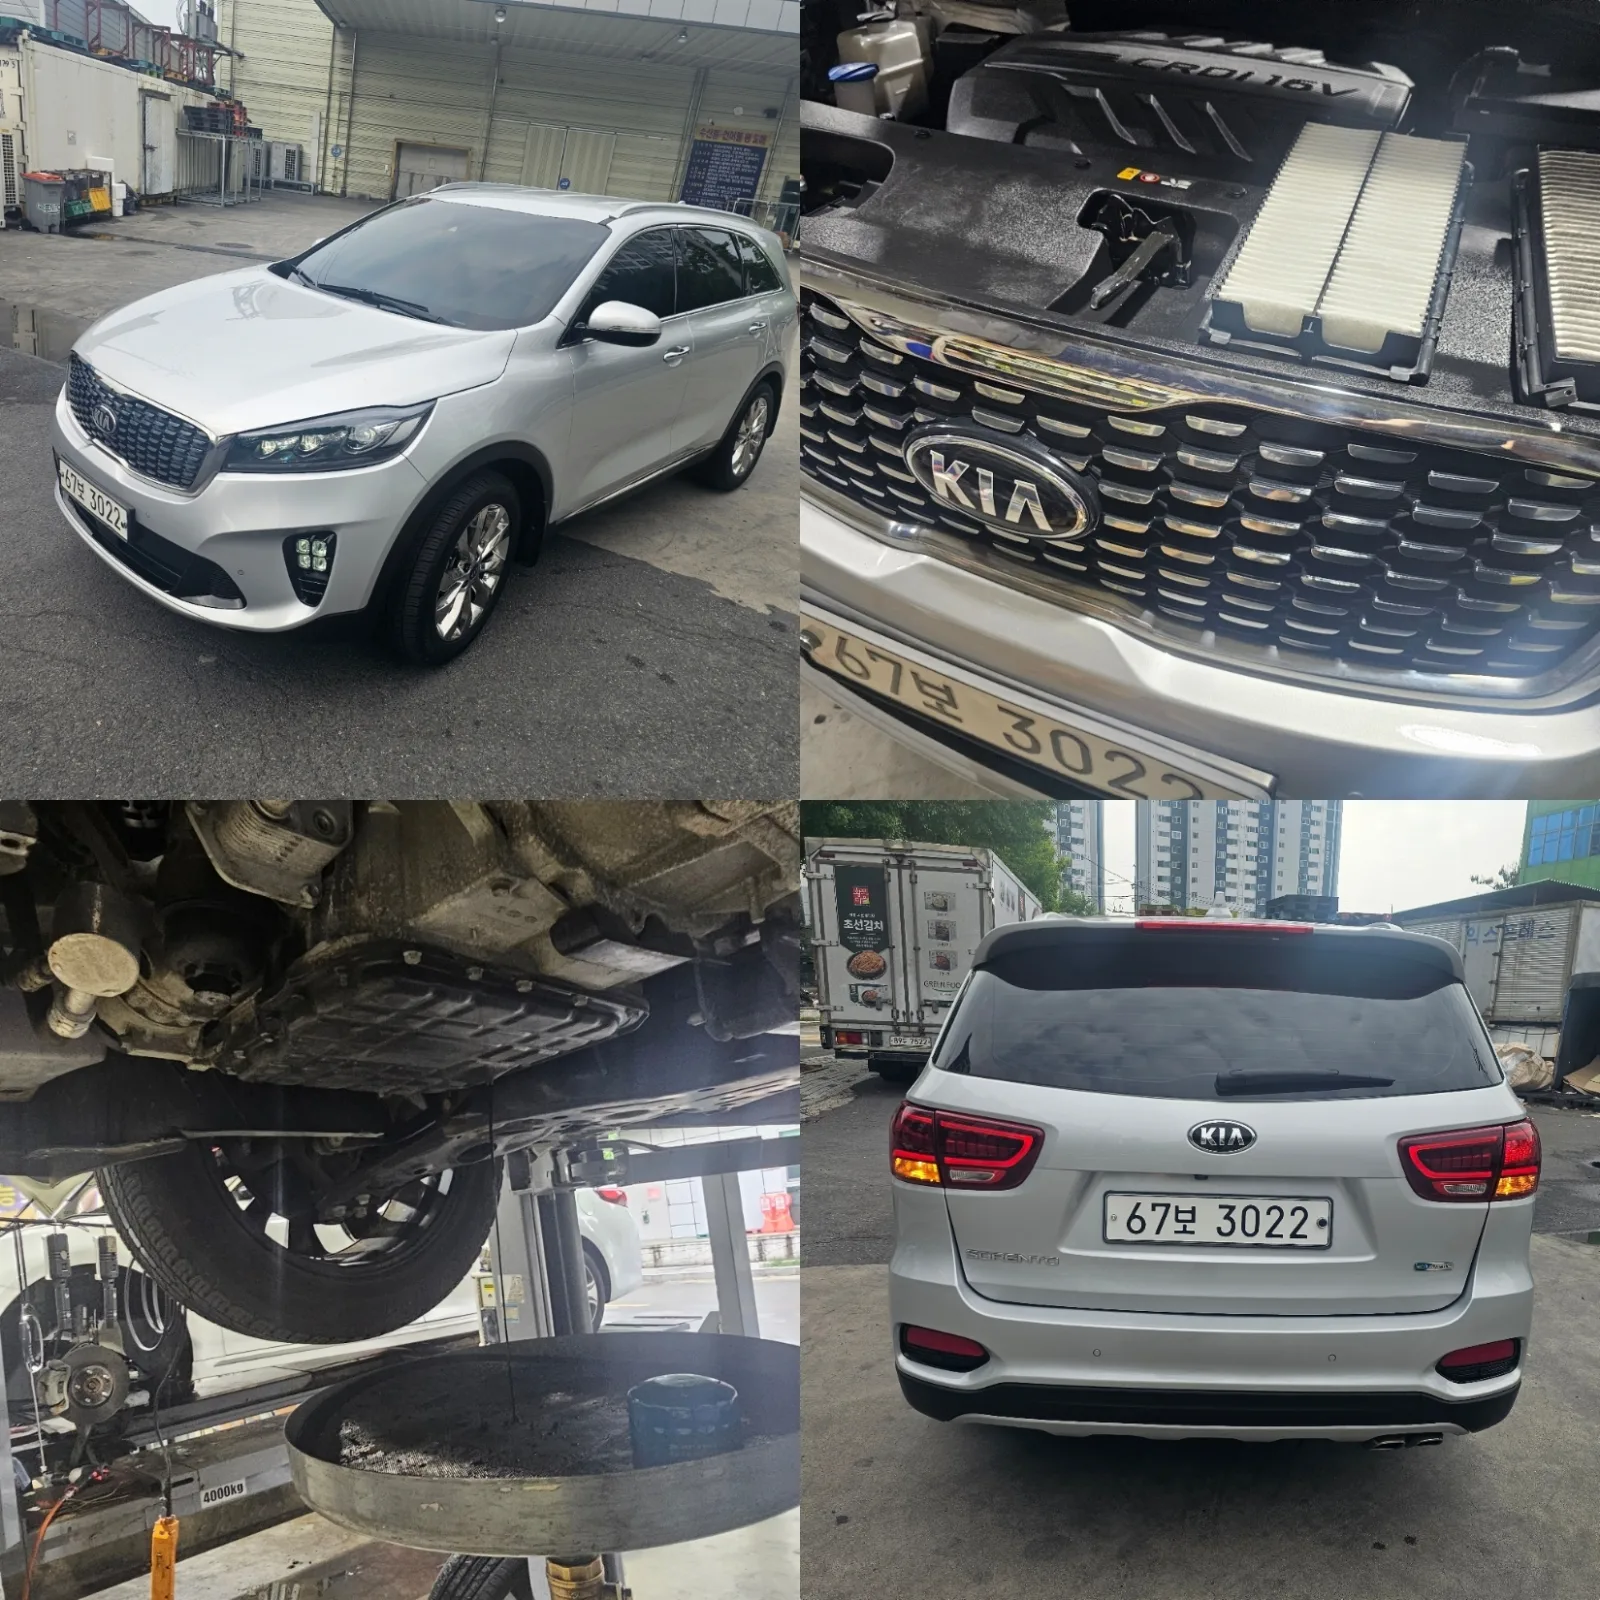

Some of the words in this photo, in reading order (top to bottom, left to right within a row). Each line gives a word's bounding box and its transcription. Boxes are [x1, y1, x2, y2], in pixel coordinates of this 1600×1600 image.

[1269, 73, 1361, 97] 16V
[93, 407, 111, 431] KIA
[65, 468, 86, 501] 67보
[89, 487, 122, 531] 3022
[929, 449, 1054, 533] KIA
[834, 636, 964, 724] 67보
[842, 918, 884, 932] 조선김치
[1200, 1126, 1246, 1146] KIA
[1125, 1201, 1197, 1235] 67보
[1215, 1203, 1310, 1240] 3022
[965, 1248, 1060, 1267] SORENTO
[203, 1482, 245, 1504] 4000kg
